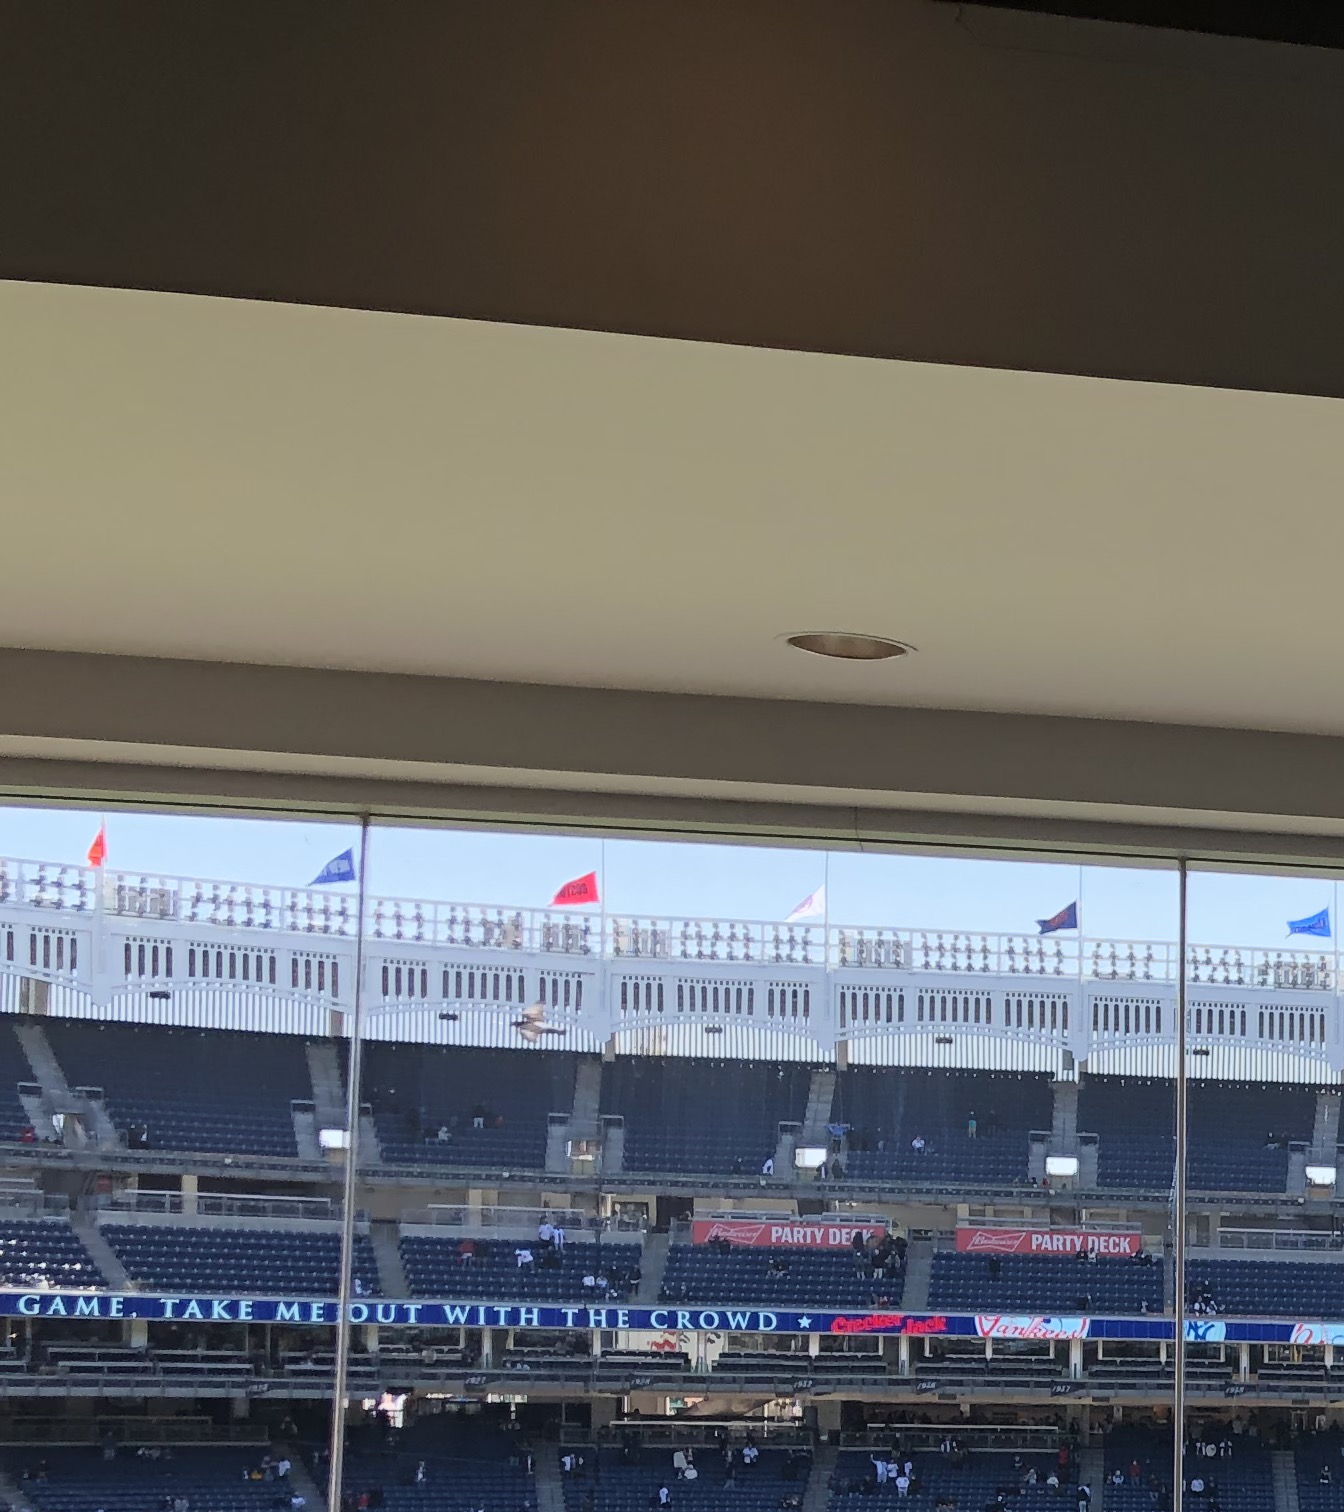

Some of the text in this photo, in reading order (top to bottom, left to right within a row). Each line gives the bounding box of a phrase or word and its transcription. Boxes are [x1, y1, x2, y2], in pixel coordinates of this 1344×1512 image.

[771, 1226, 824, 1245] PARTY
[1031, 1233, 1083, 1251] PARTY
[1088, 1235, 1131, 1253] DECK
[18, 1295, 778, 1331] GAME, TAKE ME OUT WITH THE CROWD
